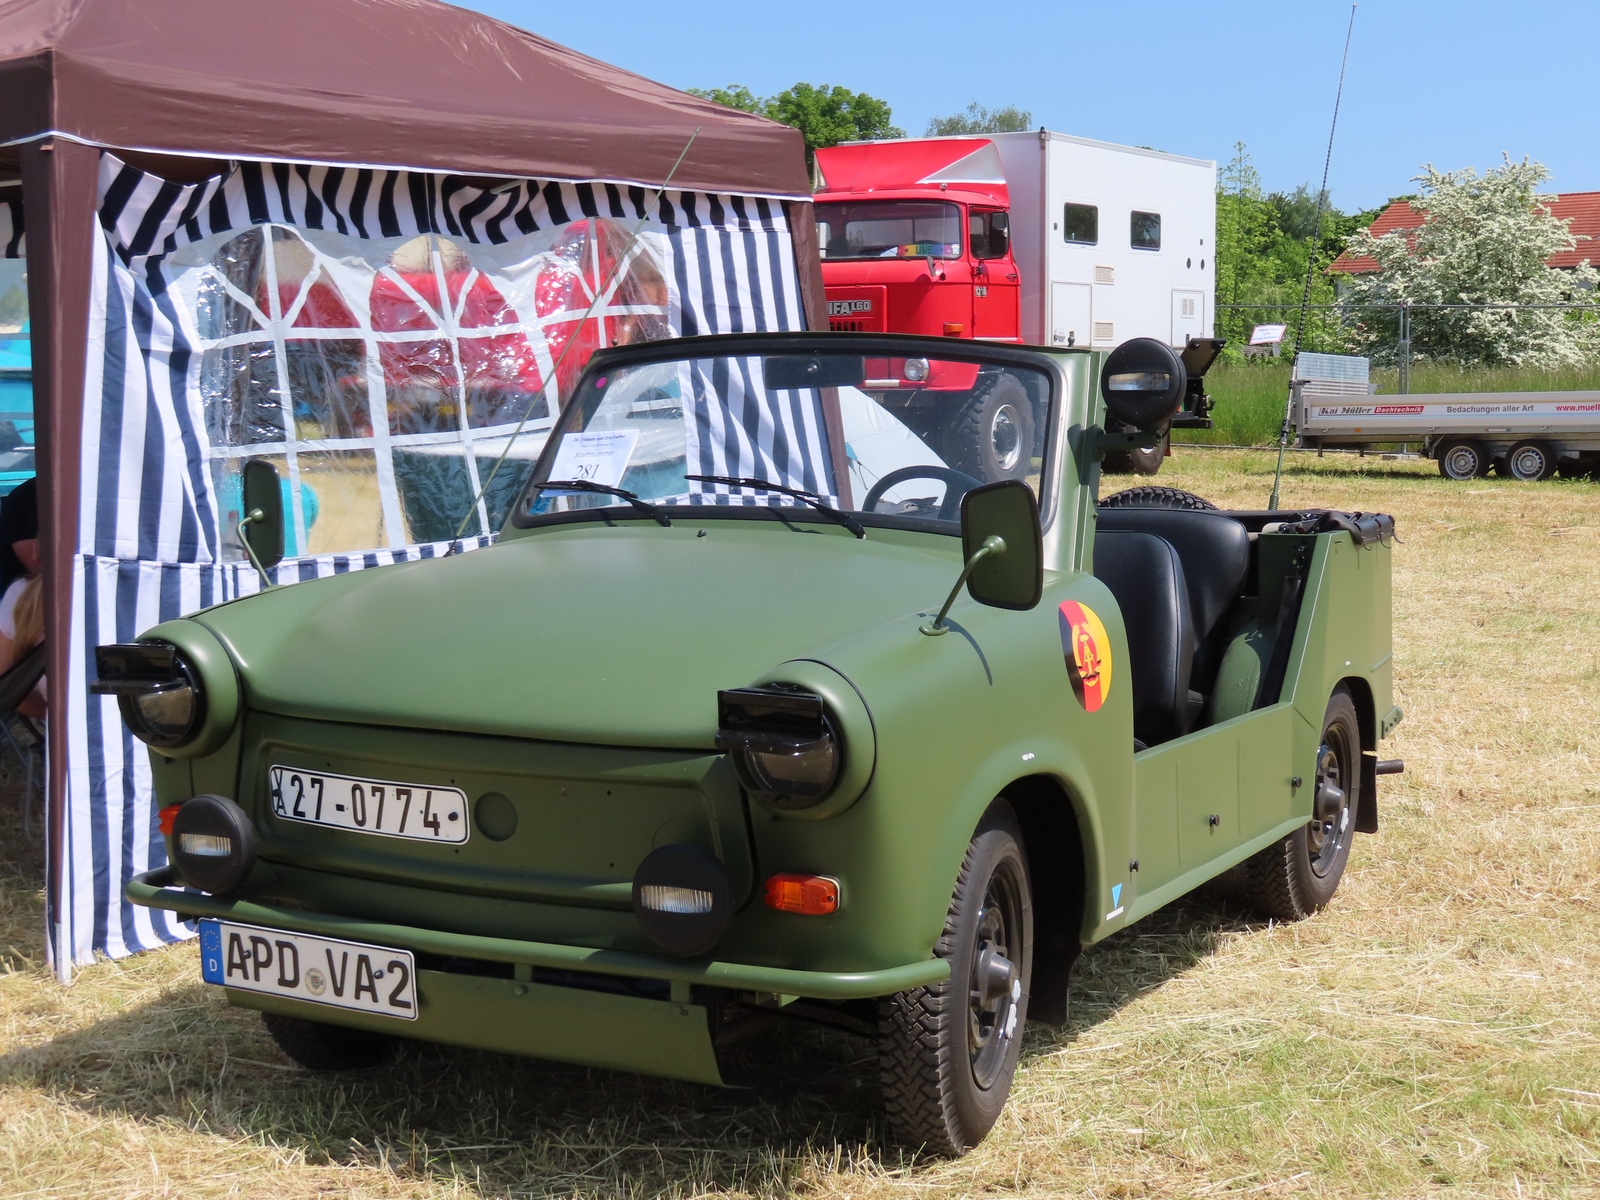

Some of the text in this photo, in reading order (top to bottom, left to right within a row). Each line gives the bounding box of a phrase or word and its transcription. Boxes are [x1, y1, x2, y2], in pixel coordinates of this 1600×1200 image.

[915, 245, 933, 255] UWE
[828, 301, 870, 315] IFA L60
[1341, 406, 1372, 415] Müller
[1375, 405, 1423, 414] Dachtechnik
[1446, 404, 1534, 414] Bedachungen aller Art
[571, 464, 600, 480] 281
[290, 774, 441, 837] 27-0774
[209, 958, 218, 972] D
[226, 932, 300, 989] APD
